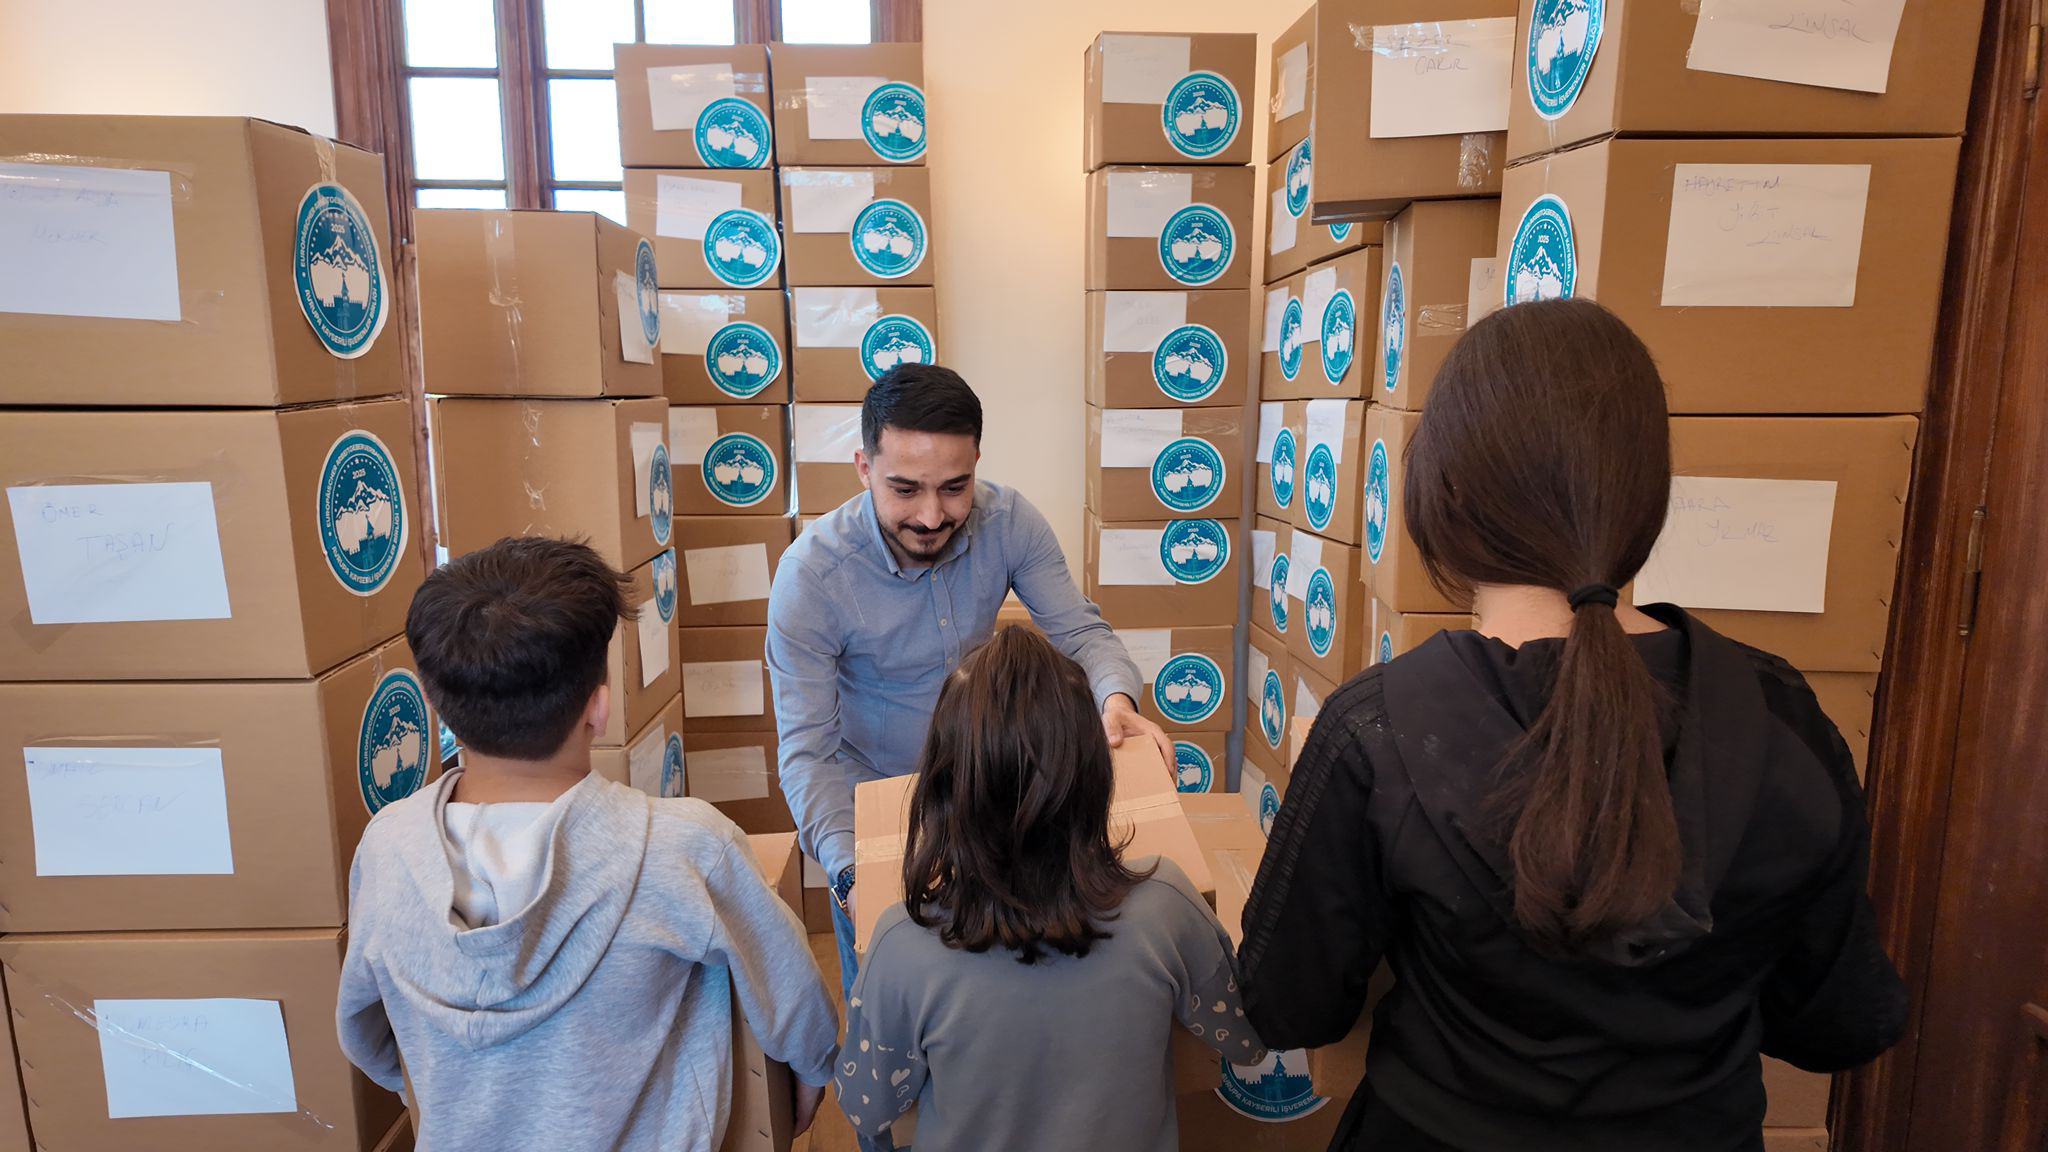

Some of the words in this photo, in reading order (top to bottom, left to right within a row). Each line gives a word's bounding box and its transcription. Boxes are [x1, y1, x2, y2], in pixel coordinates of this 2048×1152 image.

[331, 223, 345, 233] 2025
[352, 468, 366, 480] 2025
[41, 501, 104, 523] ÖMER
[1241, 1096, 1280, 1113] KAYSERİLİ
